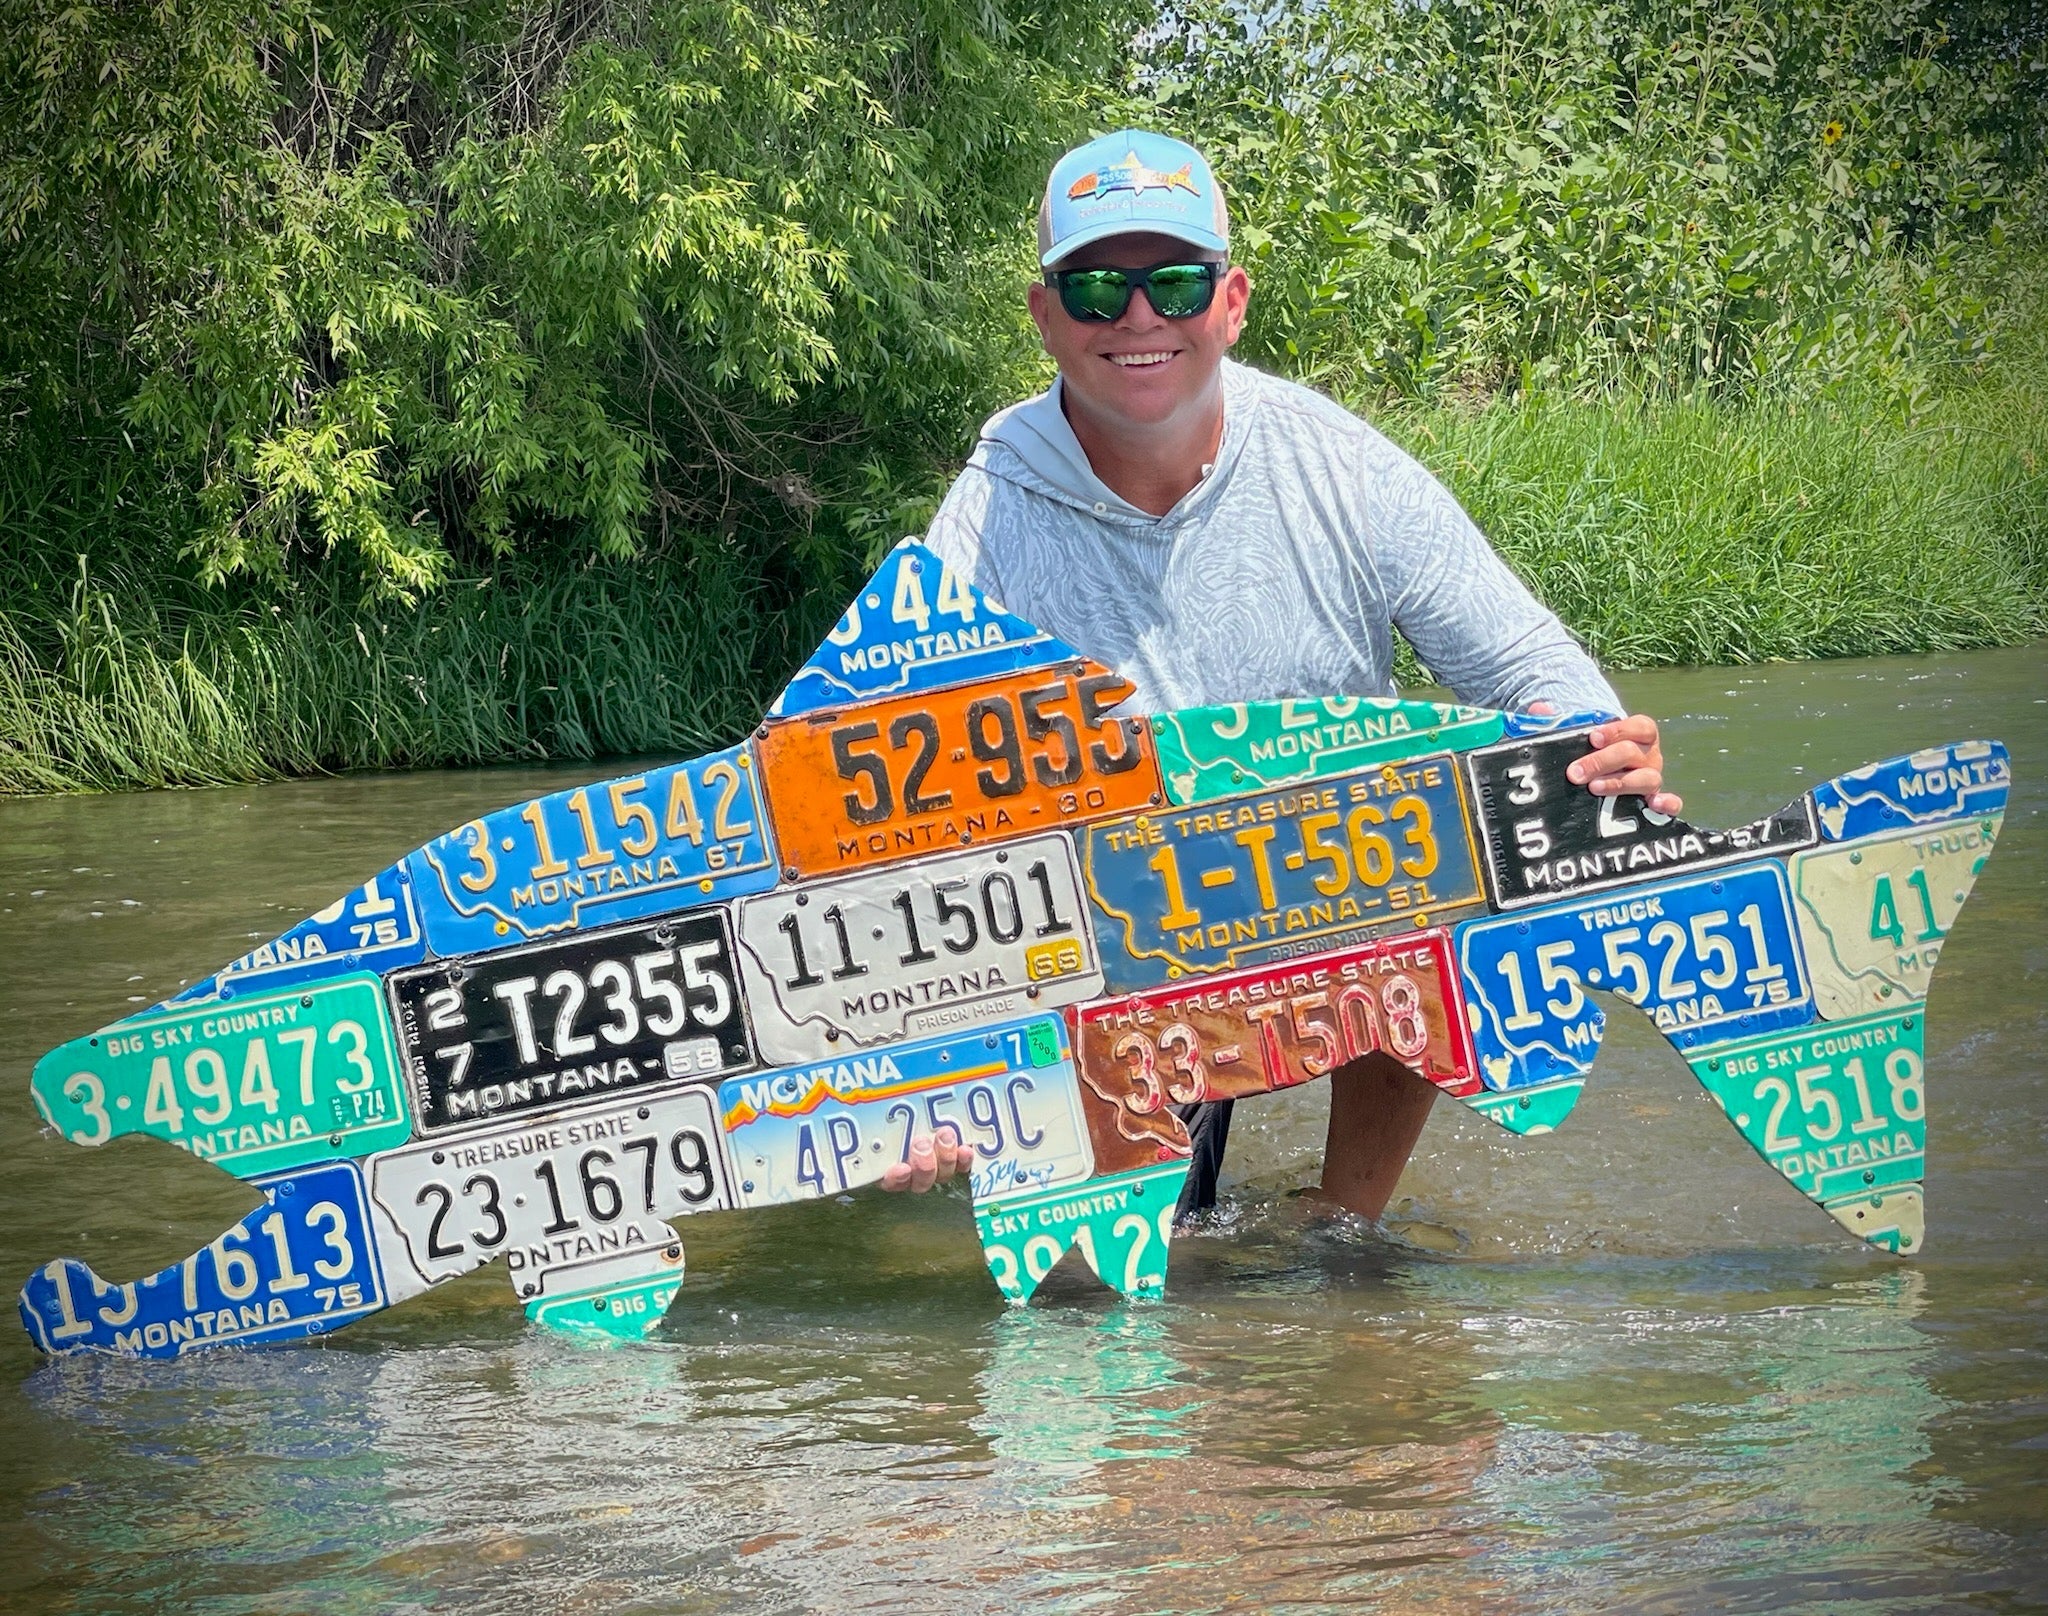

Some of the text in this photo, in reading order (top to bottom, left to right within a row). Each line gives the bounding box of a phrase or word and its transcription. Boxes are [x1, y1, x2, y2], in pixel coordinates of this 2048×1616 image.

[840, 622, 1006, 675] MONTANA
[1250, 711, 1411, 763] MONTANA
[838, 808, 1014, 860] MONTANA
[1105, 765, 1443, 852] THE TREASURE STATE
[1912, 828, 1997, 859] TRUCK
[511, 842, 745, 910] MONTANA 67
[350, 919, 399, 947] 75
[1578, 896, 1665, 931] TRUCK
[494, 940, 732, 1065] T2355
[843, 964, 1008, 1019] MONTANA
[917, 998, 1016, 1031] PRISON MADE
[1096, 947, 1434, 1033] THE TREASURE STATE
[1744, 978, 1789, 1007] 75
[107, 1004, 299, 1058] BIG SKY COUNTRY
[1006, 1032, 1022, 1066] 7
[1032, 1037, 1056, 1060] 2000
[1725, 1025, 1898, 1078] BIG SKY COUNTRY
[740, 1053, 902, 1110] MONTANA
[451, 1115, 633, 1169] TREASURE STATE
[991, 1212, 1030, 1238] SKY
[1038, 1190, 1128, 1227] COUNTRY
[114, 1283, 363, 1352] MONTANA 75
[611, 1295, 646, 1318] BIG
